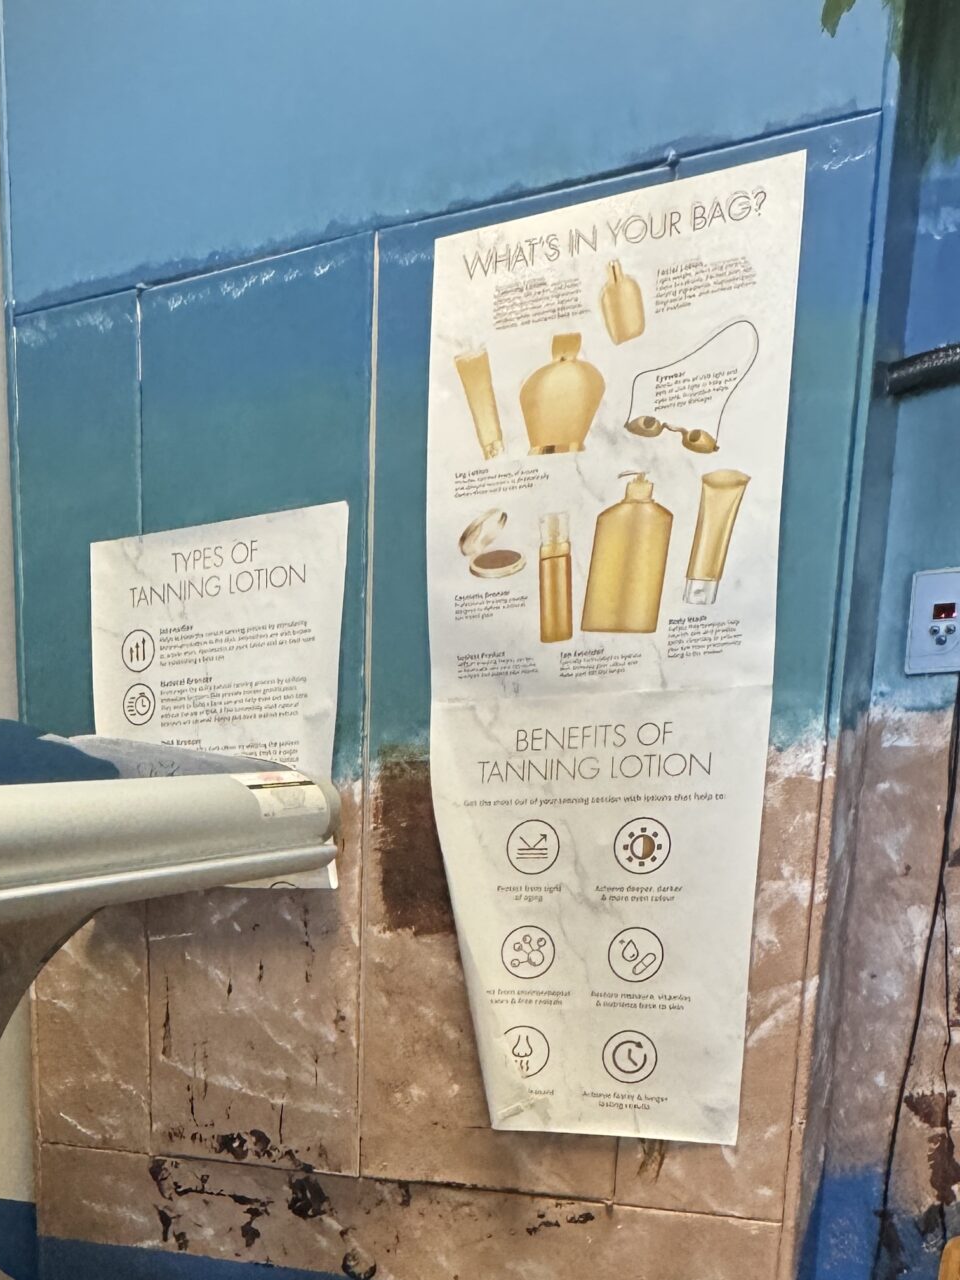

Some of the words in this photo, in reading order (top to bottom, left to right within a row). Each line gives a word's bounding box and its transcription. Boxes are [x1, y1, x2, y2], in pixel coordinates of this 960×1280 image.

[463, 232, 561, 280] WHAT'S
[569, 224, 597, 257] IN
[606, 211, 683, 247] YOUR
[692, 191, 767, 231] BAG?
[656, 371, 685, 383] Eyewear
[171, 545, 224, 574] TYPES
[231, 539, 258, 564] OF
[130, 575, 221, 608] TANNING
[229, 564, 306, 594] LOTION
[516, 723, 626, 752] BENEFITS
[636, 721, 673, 746] OF
[478, 755, 600, 785] TANNING
[610, 752, 712, 780] LOTION
[539, 798, 557, 807] your
[624, 794, 642, 802] with
[674, 793, 691, 801] that
[694, 792, 713, 800] help
